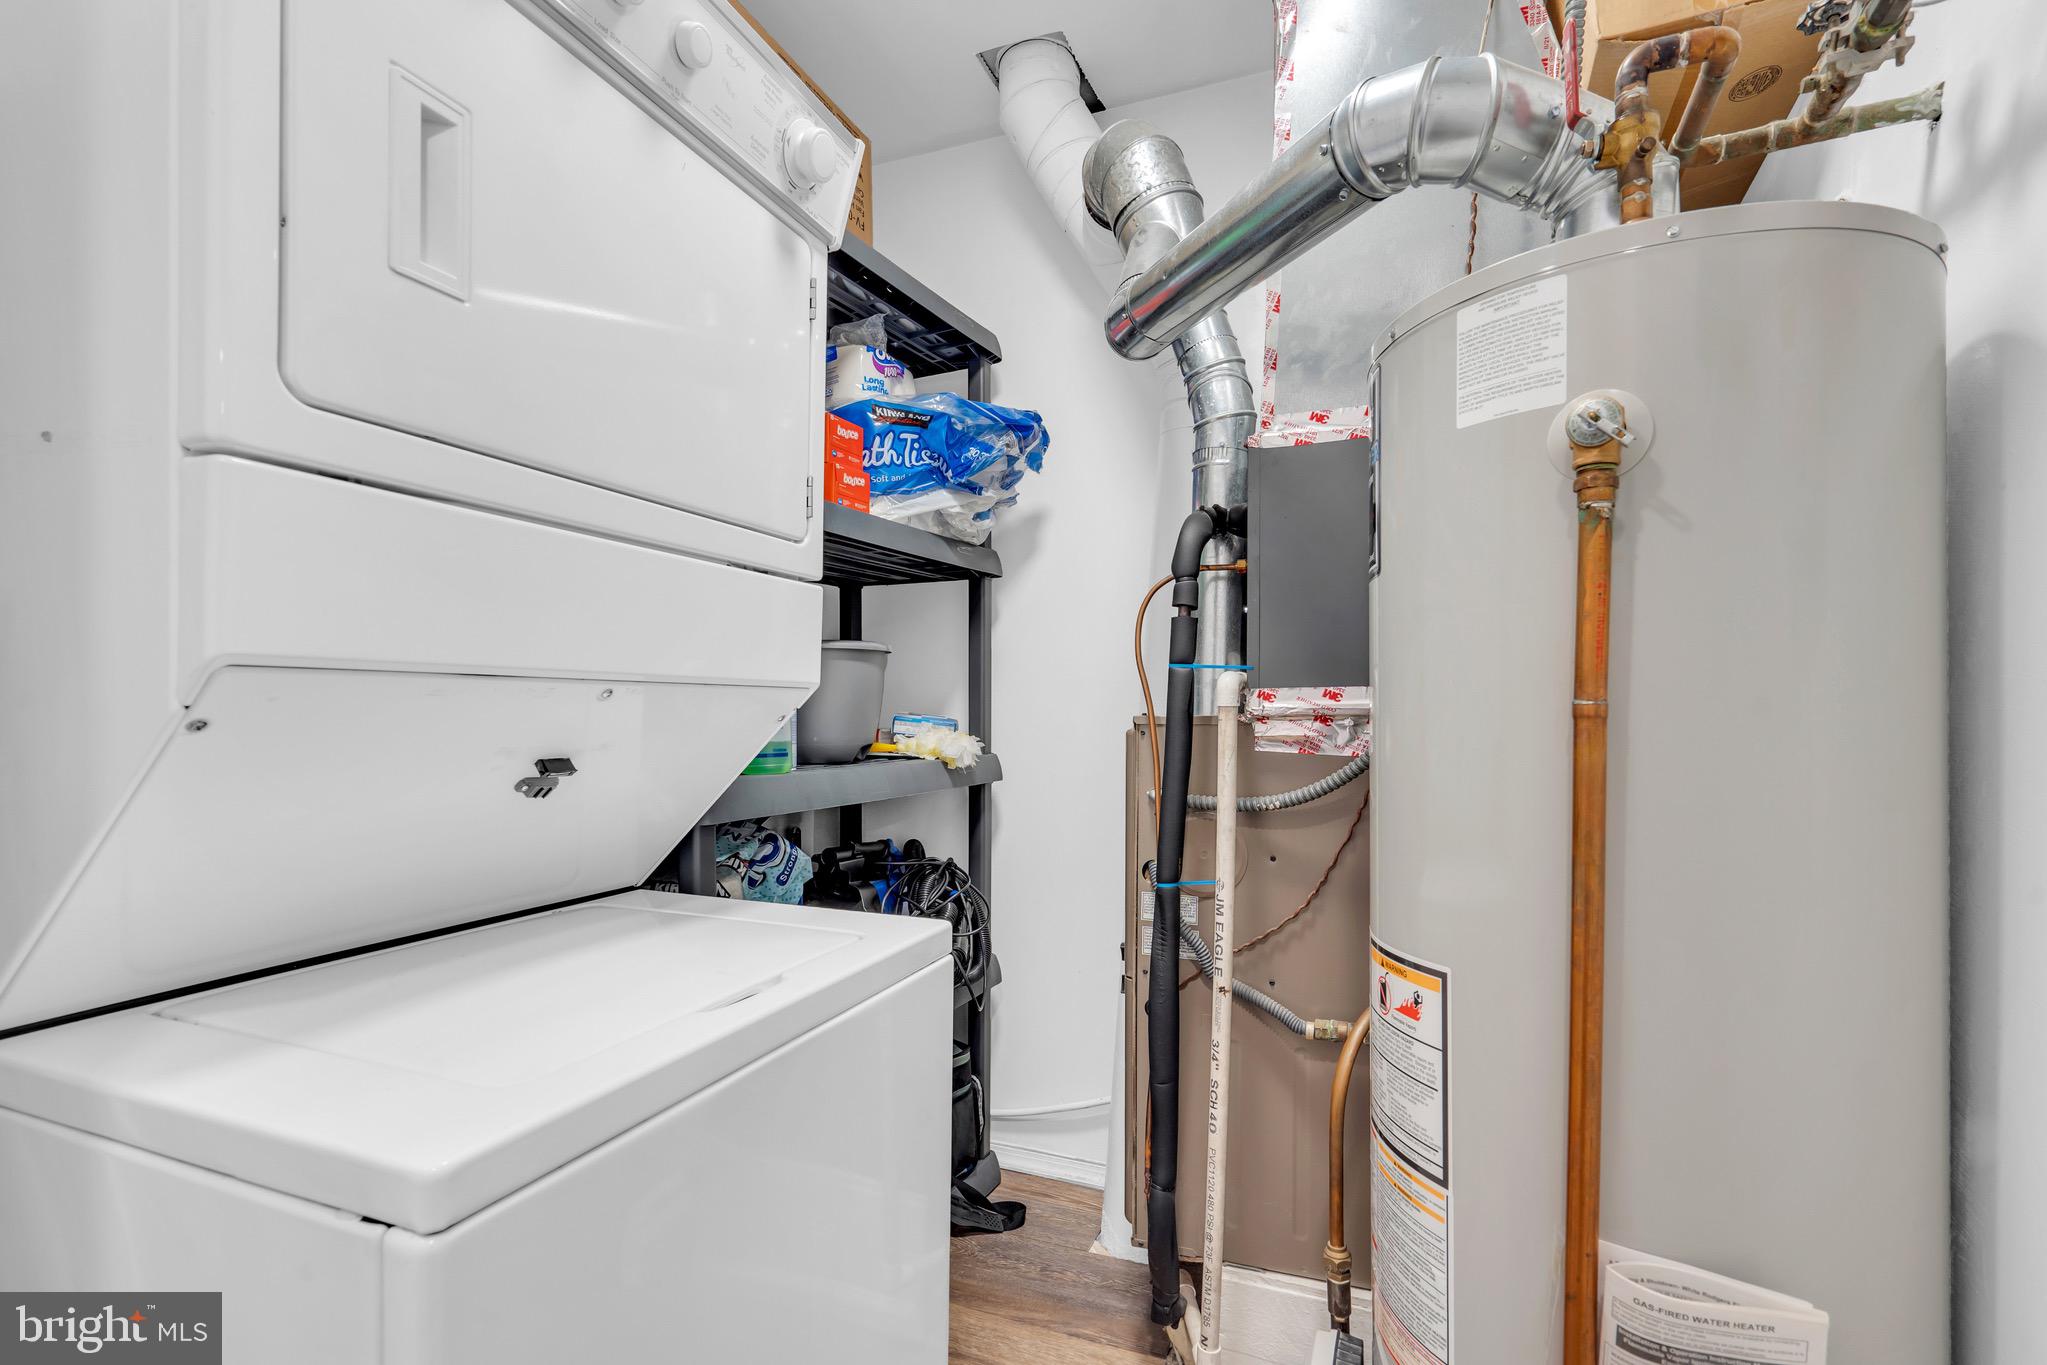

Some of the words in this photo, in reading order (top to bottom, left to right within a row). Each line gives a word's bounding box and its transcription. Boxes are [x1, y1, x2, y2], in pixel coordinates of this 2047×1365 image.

[864, 376, 885, 388] Long
[1308, 410, 1330, 425] 3M
[836, 425, 859, 440] bounce
[843, 473, 866, 487] bounce
[870, 474, 888, 484] Soft
[1256, 689, 1277, 703] 3M
[1322, 688, 1344, 702] 3M
[780, 846, 798, 882] Strong
[1215, 894, 1224, 916] JM
[1214, 922, 1224, 978] EAGLE
[1384, 962, 1408, 978] WARNING
[1211, 1039, 1220, 1071] 3/4"
[1210, 1078, 1219, 1110] SCH
[1209, 1111, 1217, 1134] 40
[1204, 1267, 1213, 1296] ASTM
[1203, 1297, 1212, 1328] D1785
[1632, 1297, 1690, 1321] GAS-FIRED
[1692, 1316, 1730, 1328] WATER
[1733, 1323, 1776, 1333] HEATER
